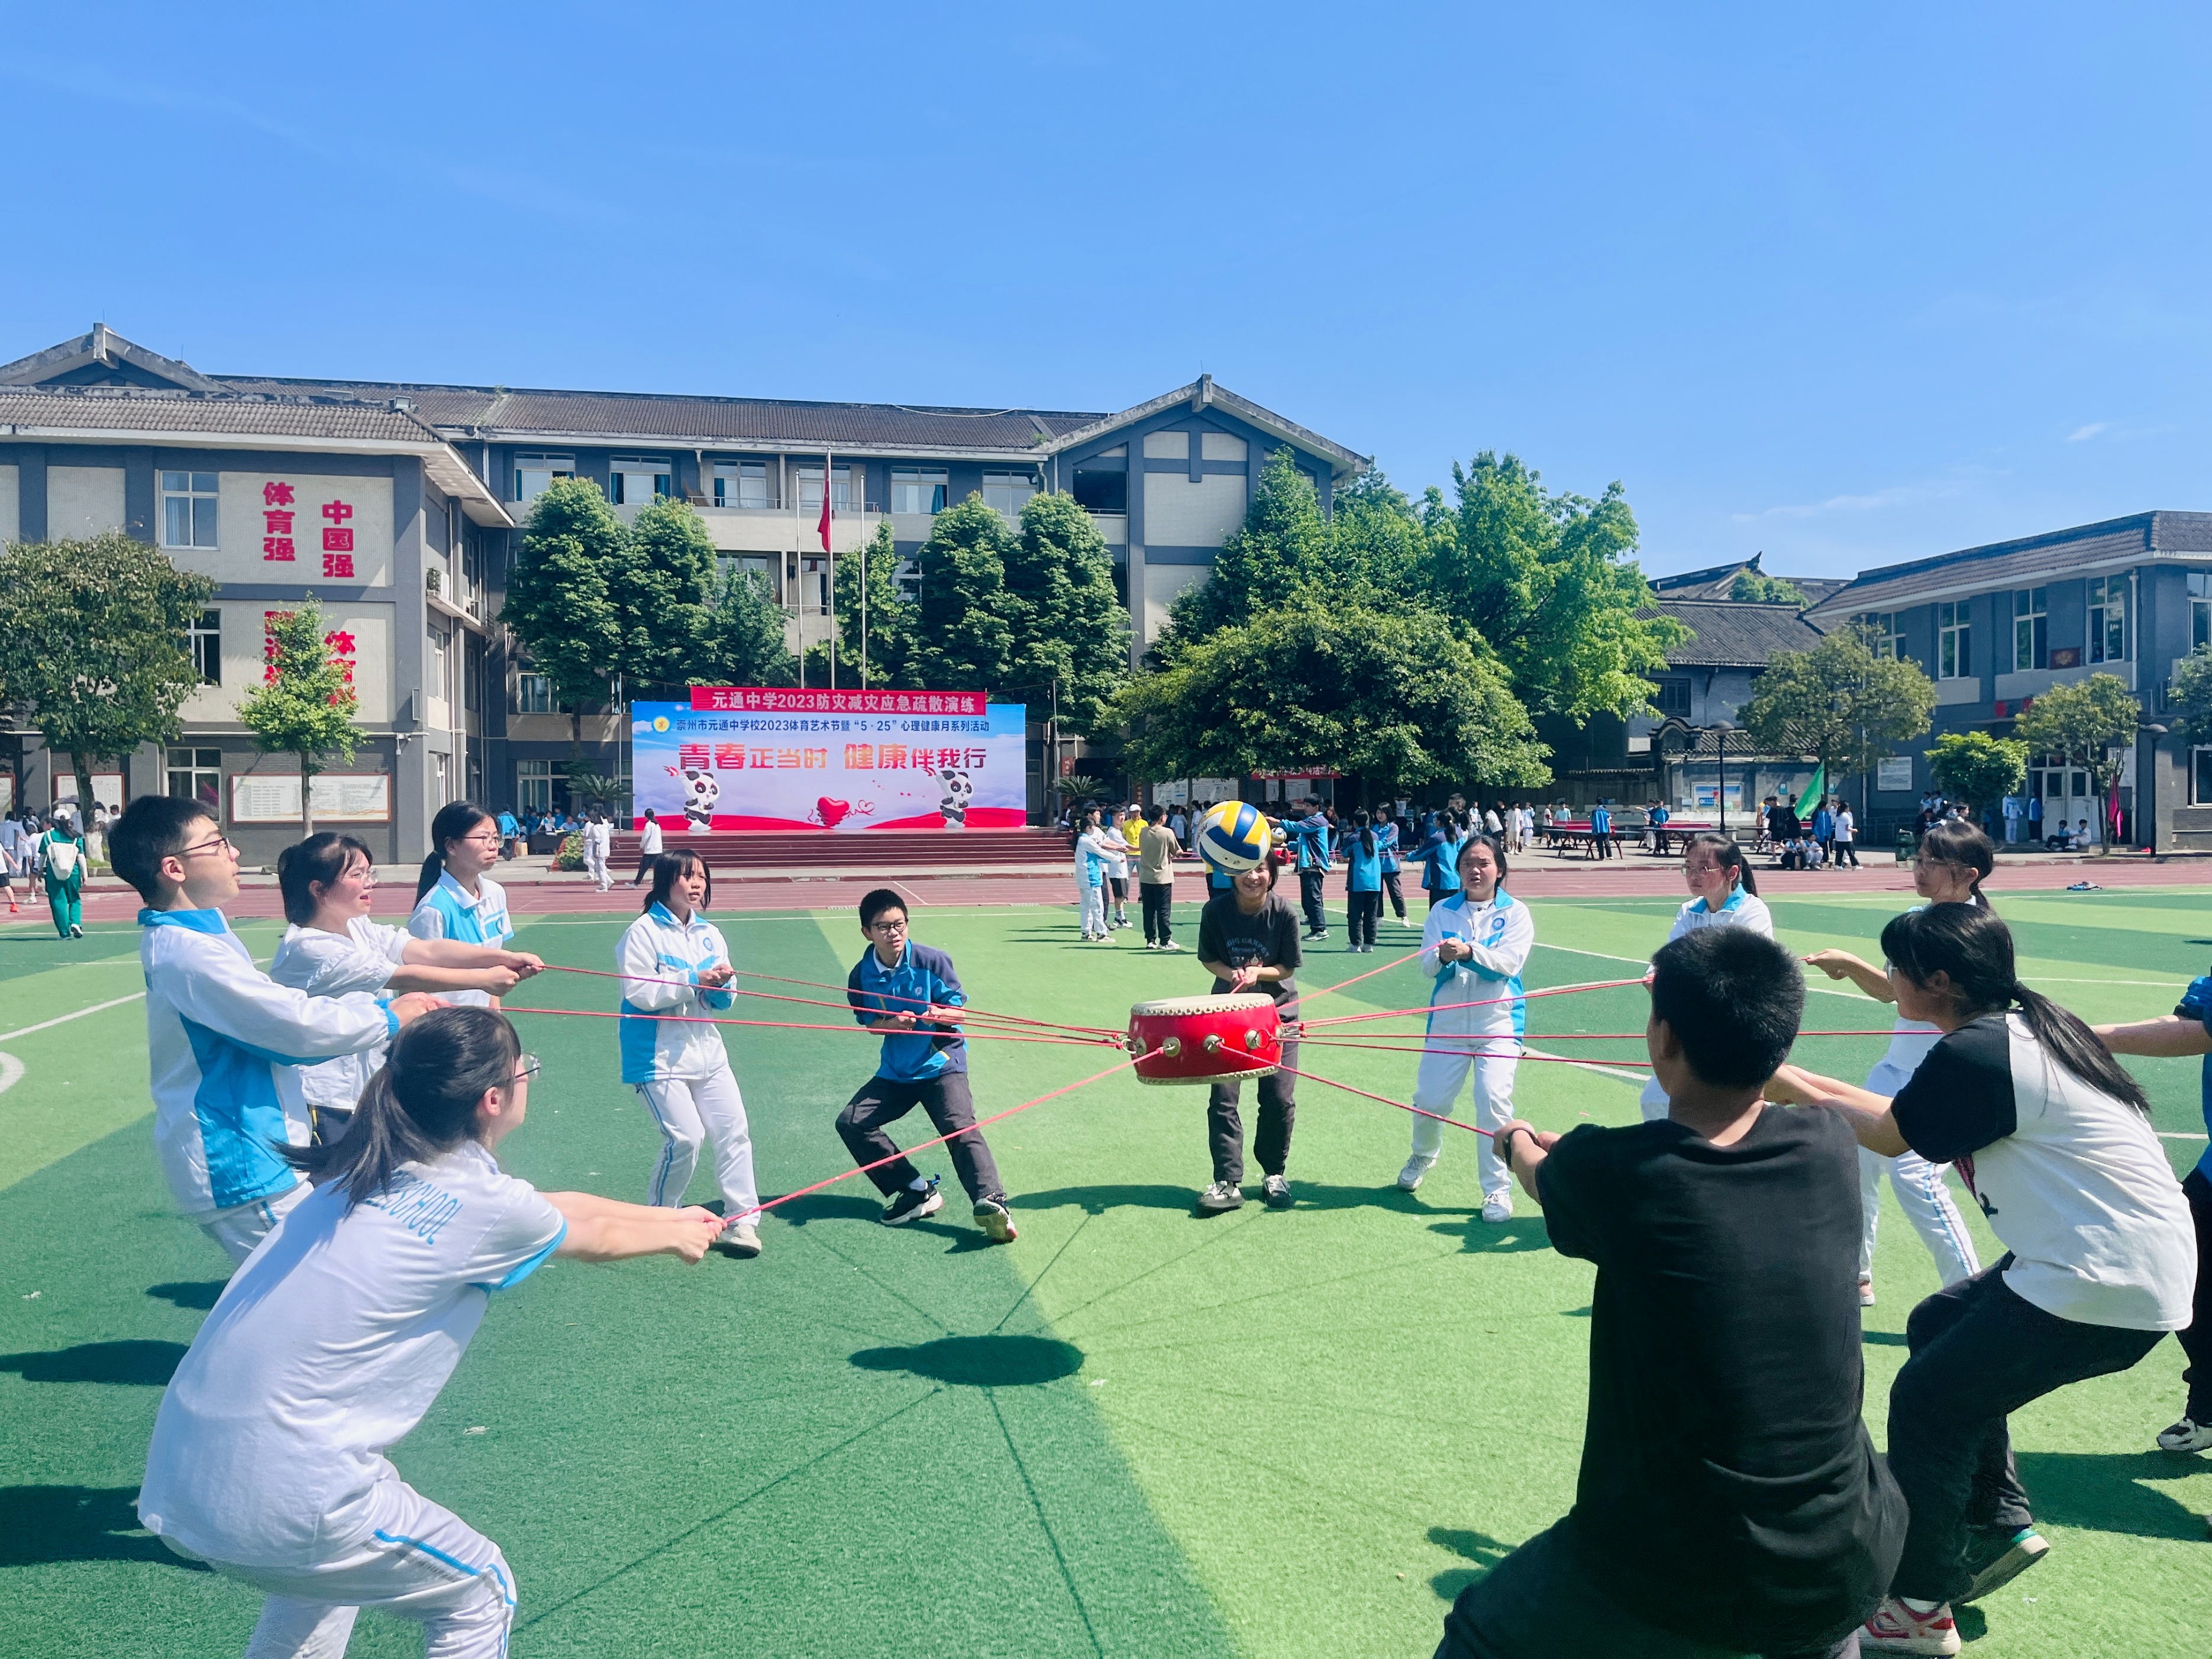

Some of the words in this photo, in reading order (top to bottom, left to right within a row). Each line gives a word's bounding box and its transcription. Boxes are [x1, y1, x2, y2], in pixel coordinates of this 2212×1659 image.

[263, 482, 295, 561] 体育强
[322, 500, 355, 578] 中国强
[712, 691, 976, 714] 元通中学2023防灾减灾应急疏散演练
[679, 743, 828, 770] 青春正当时
[843, 743, 987, 769] 健康伴我行
[379, 1180, 464, 1245] SCHOOL
